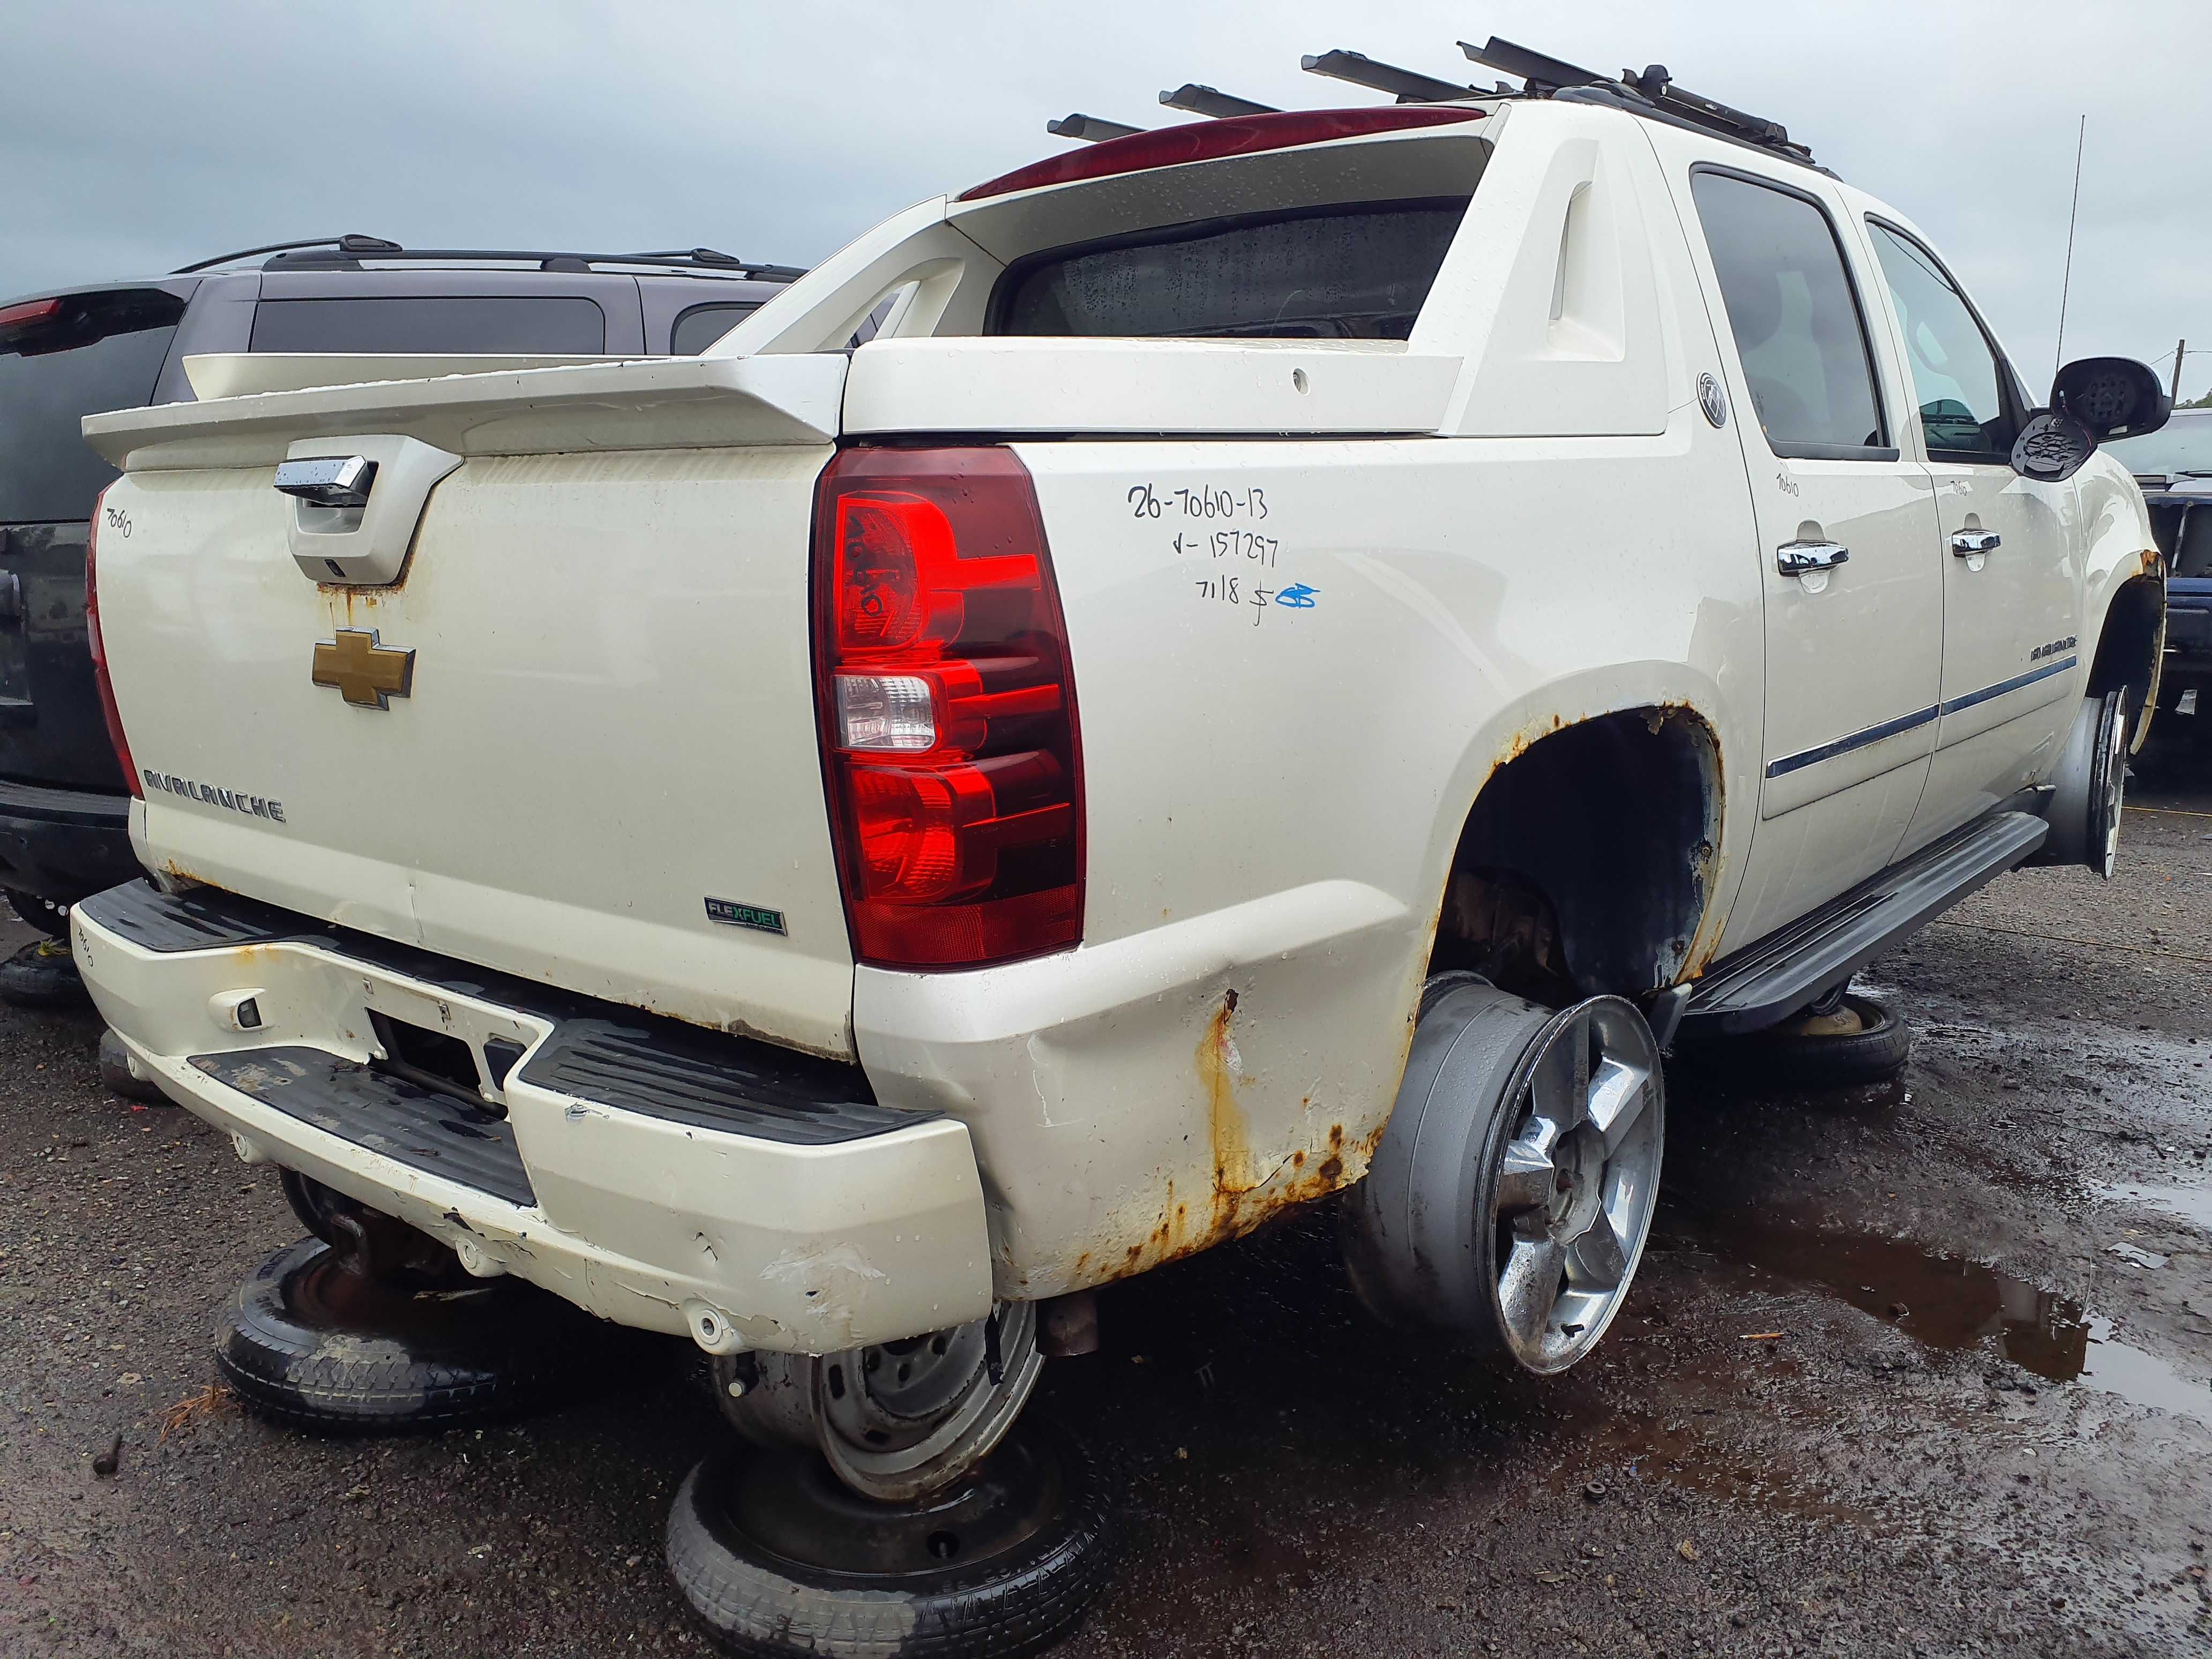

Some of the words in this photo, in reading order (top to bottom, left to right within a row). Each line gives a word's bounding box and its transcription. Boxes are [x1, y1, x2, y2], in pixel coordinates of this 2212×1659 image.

[1128, 483, 1268, 519] 26-70610-13
[1776, 473, 1799, 497] 70610
[107, 508, 132, 538] 70610
[1210, 530, 1278, 567] 157297
[143, 768, 287, 823] AVALANCHE
